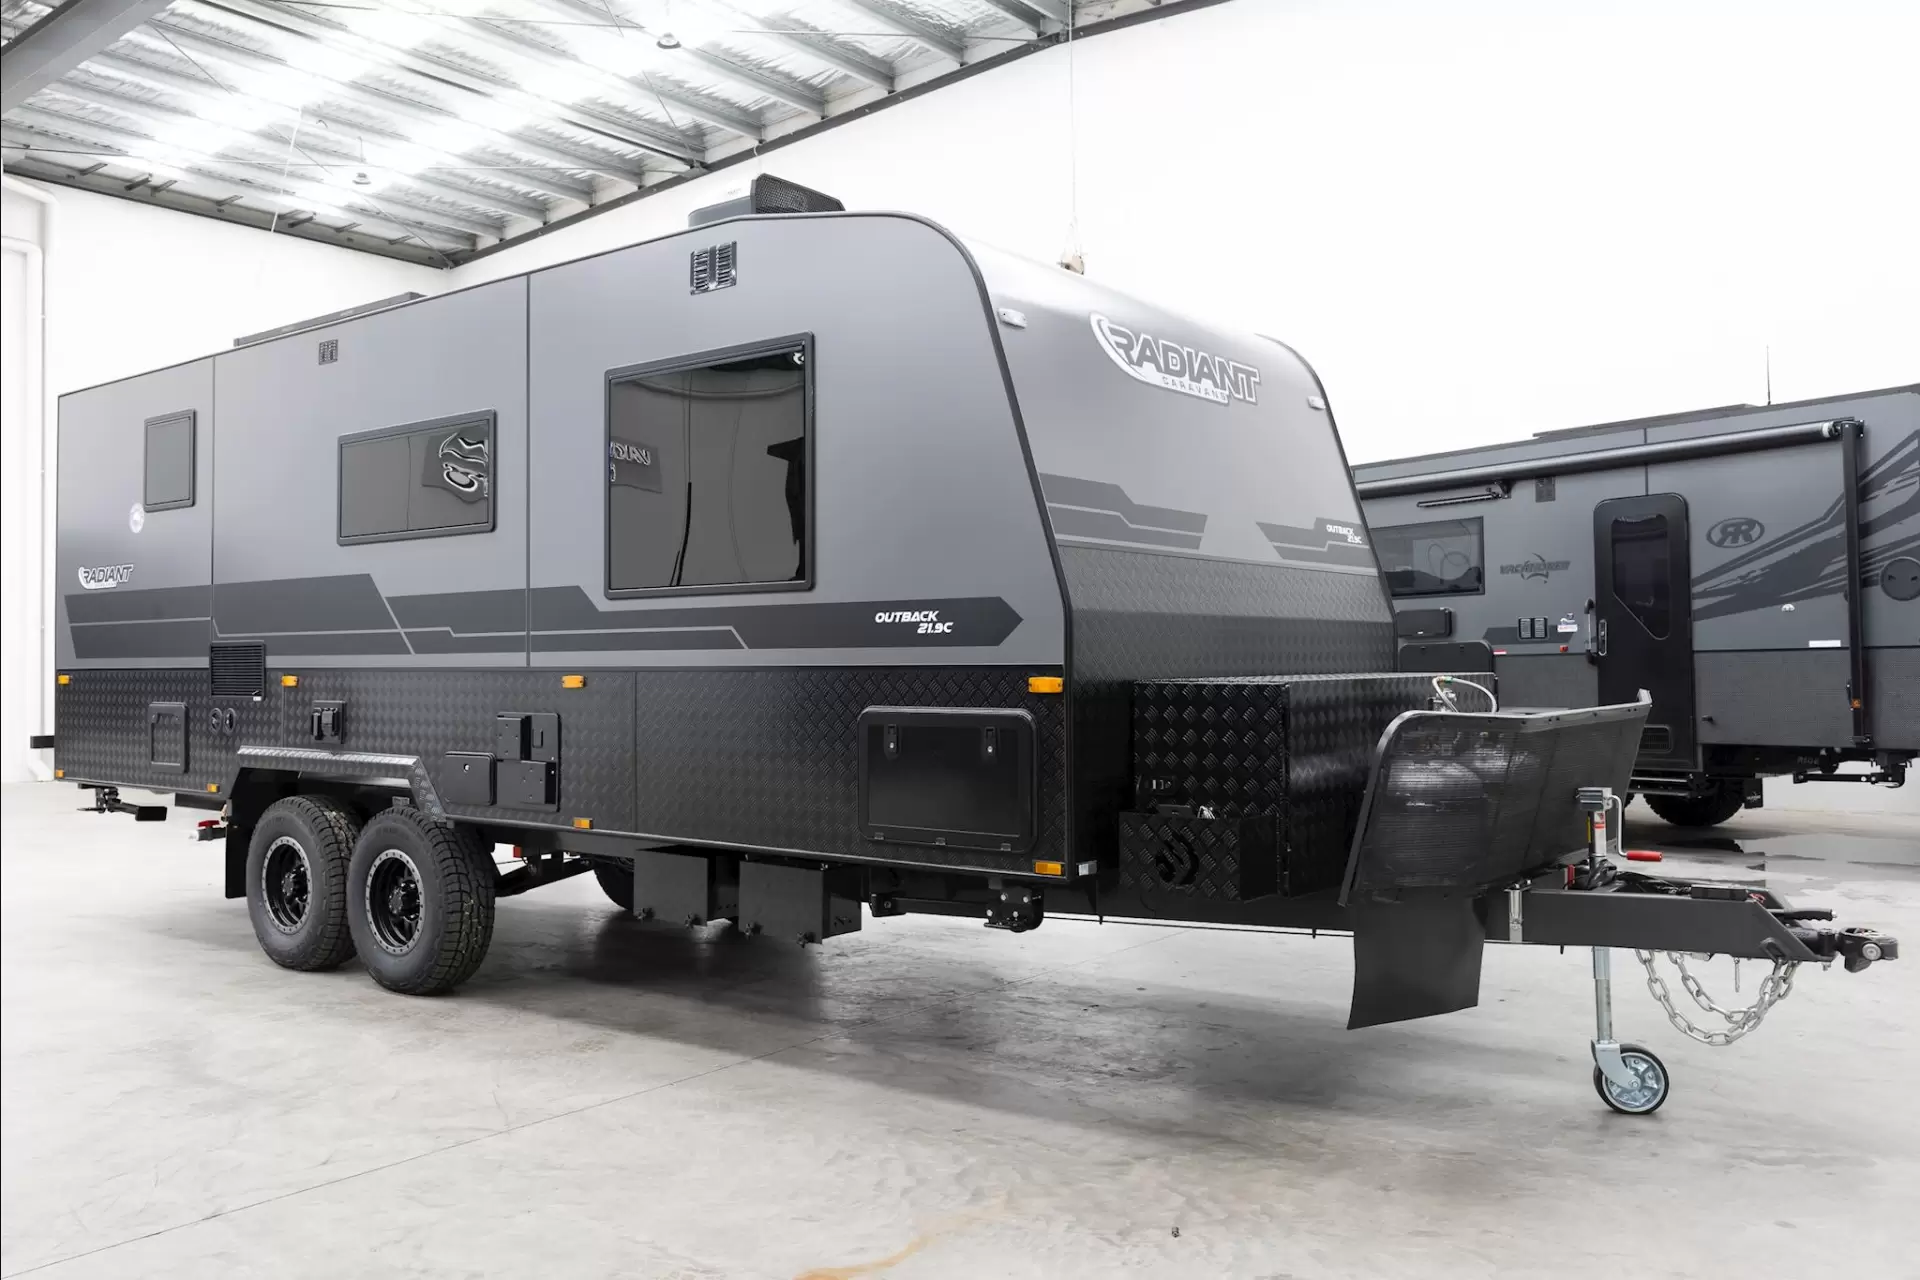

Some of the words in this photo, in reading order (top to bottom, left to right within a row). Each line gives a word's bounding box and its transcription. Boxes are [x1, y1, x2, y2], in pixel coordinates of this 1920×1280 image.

[1105, 323, 1260, 404] RADIANT
[81, 564, 134, 584] RADIANT
[875, 610, 940, 623] OUTBACK
[916, 621, 954, 634] 21.9C
